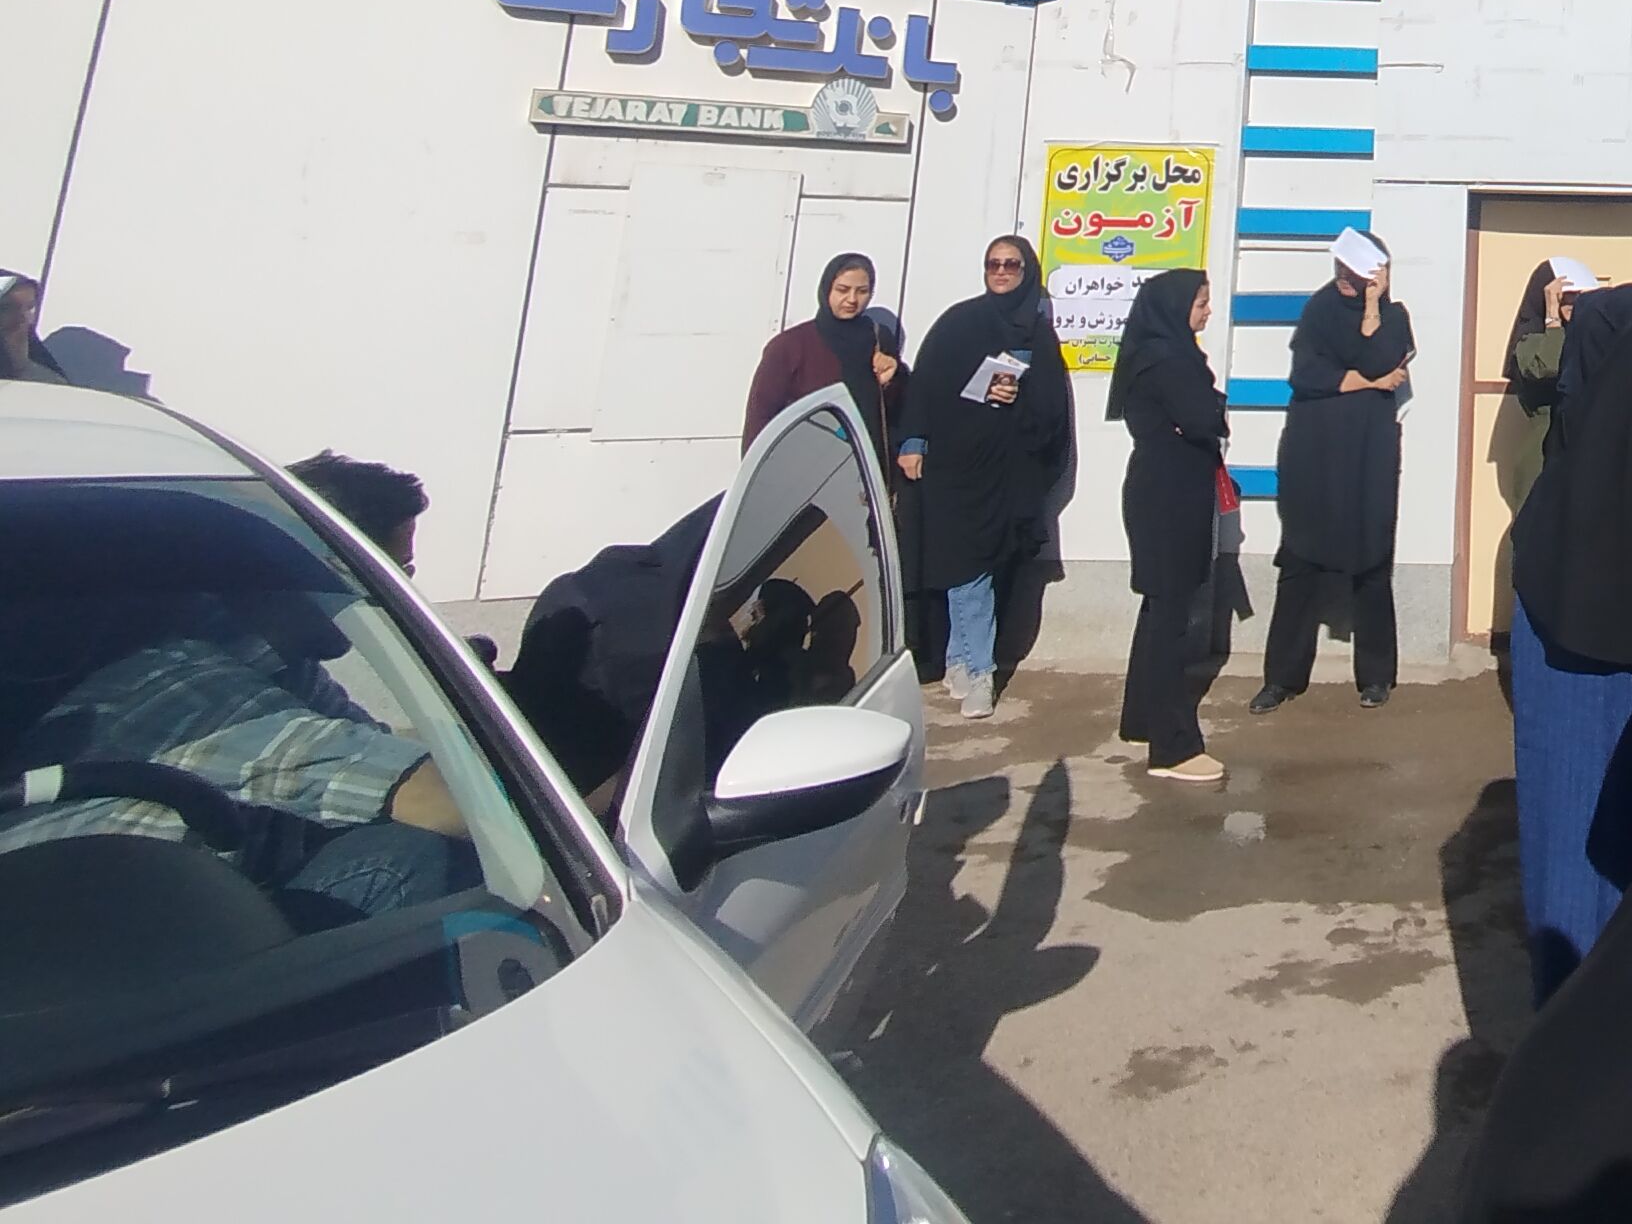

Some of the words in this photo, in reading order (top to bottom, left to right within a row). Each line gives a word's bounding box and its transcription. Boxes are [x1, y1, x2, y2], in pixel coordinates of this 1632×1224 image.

[551, 94, 688, 127] TEJARAT
[696, 103, 786, 132] BANK
[1151, 155, 1202, 192] محل
[1052, 198, 1202, 239] آزمون
[1064, 276, 1124, 297] خواهران
[1078, 315, 1087, 329] و
[1087, 311, 1129, 331] موزش
